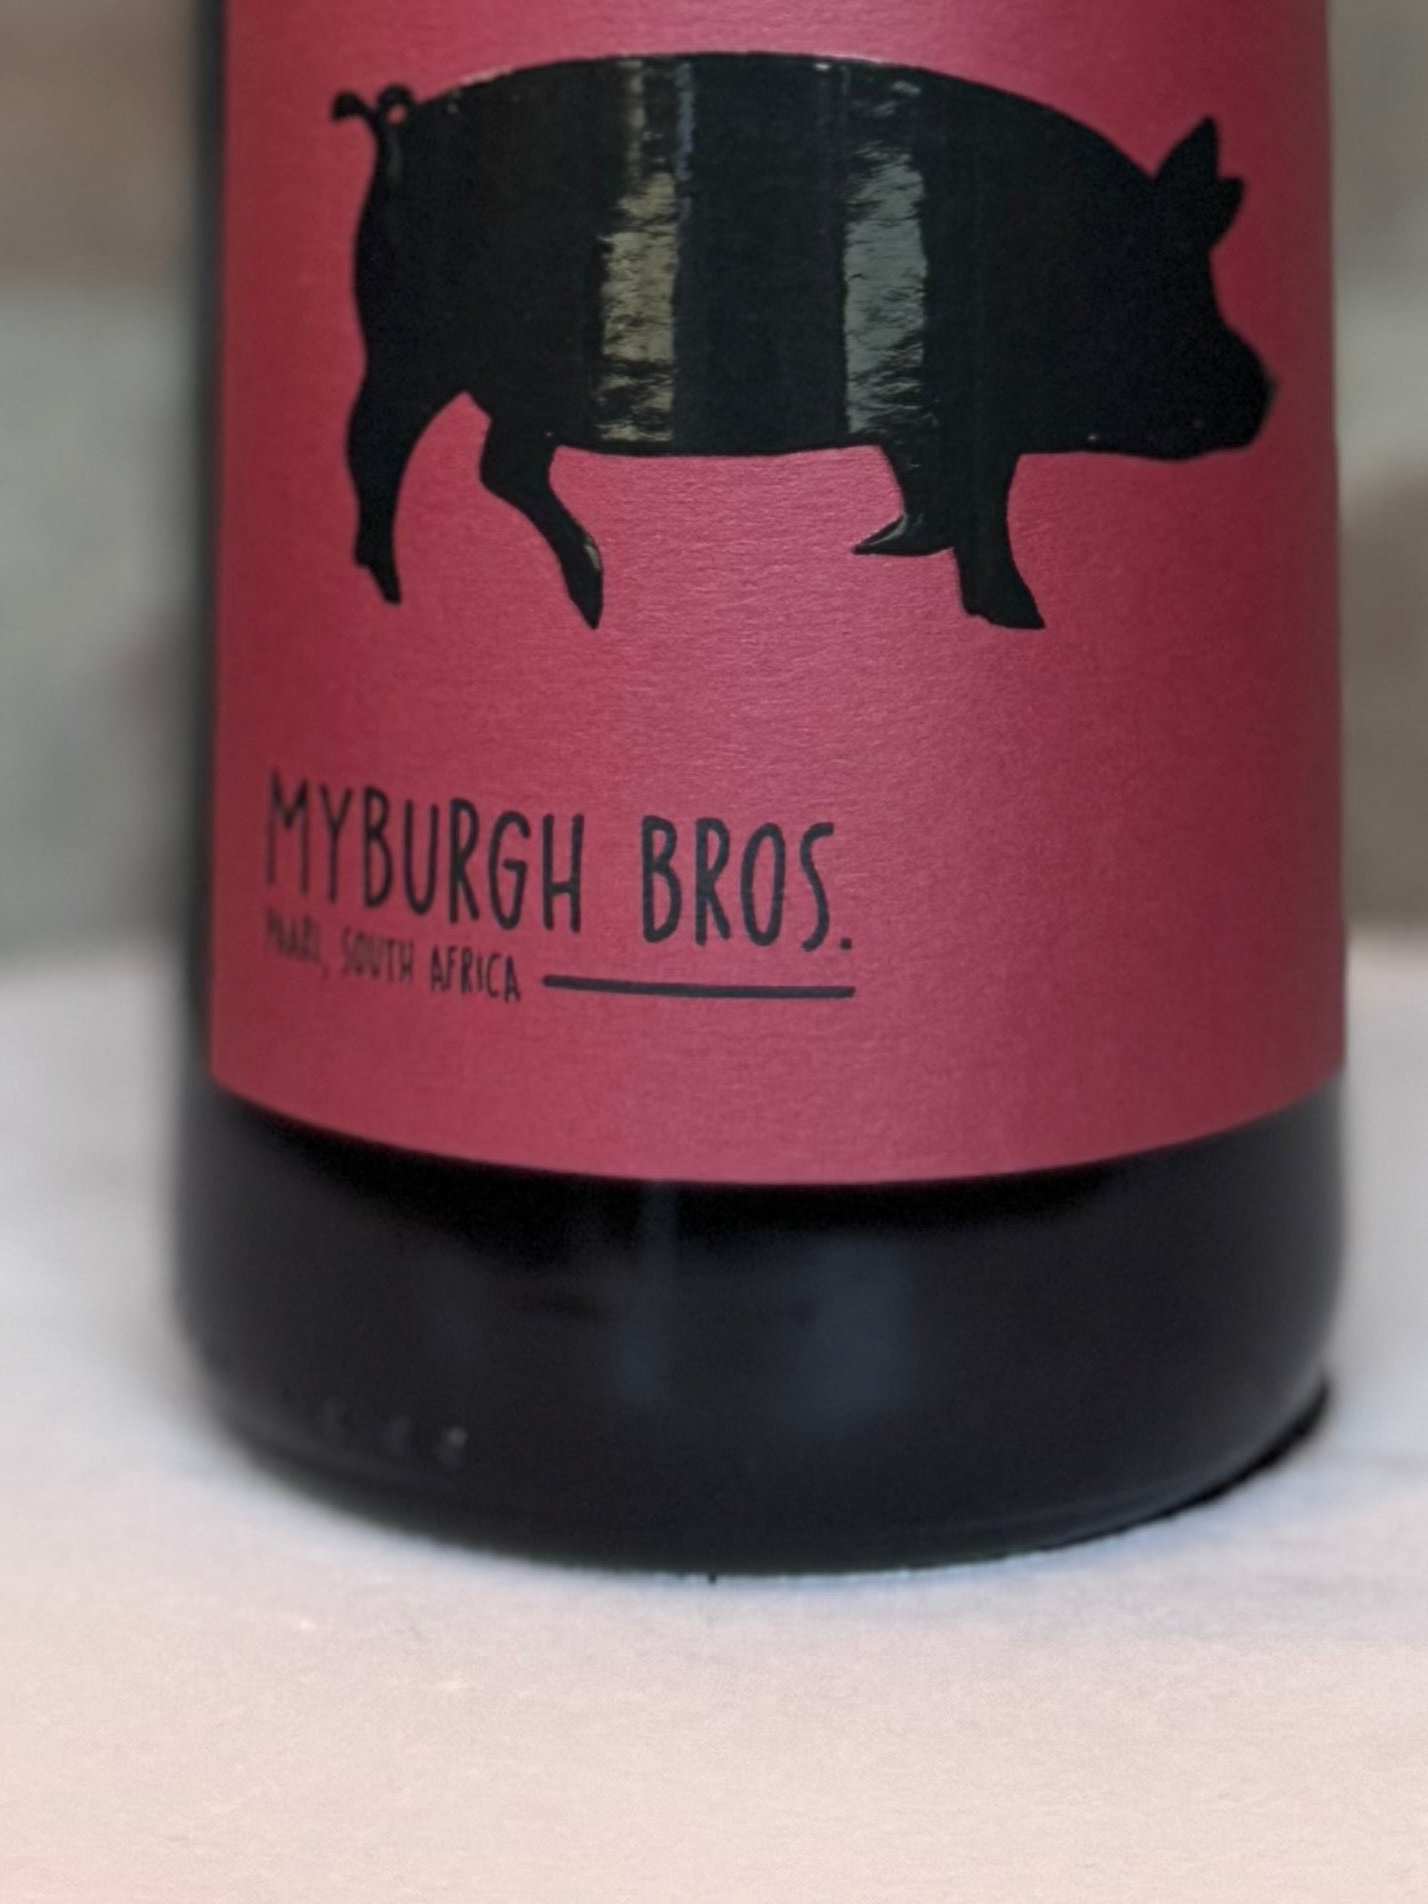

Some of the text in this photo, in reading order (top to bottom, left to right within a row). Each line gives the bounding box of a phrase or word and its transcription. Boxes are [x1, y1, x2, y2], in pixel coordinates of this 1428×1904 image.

[264, 768, 853, 952] MYBURGH BROS.
[341, 926, 414, 983] SOUTH
[431, 945, 521, 1003] AFRICA
